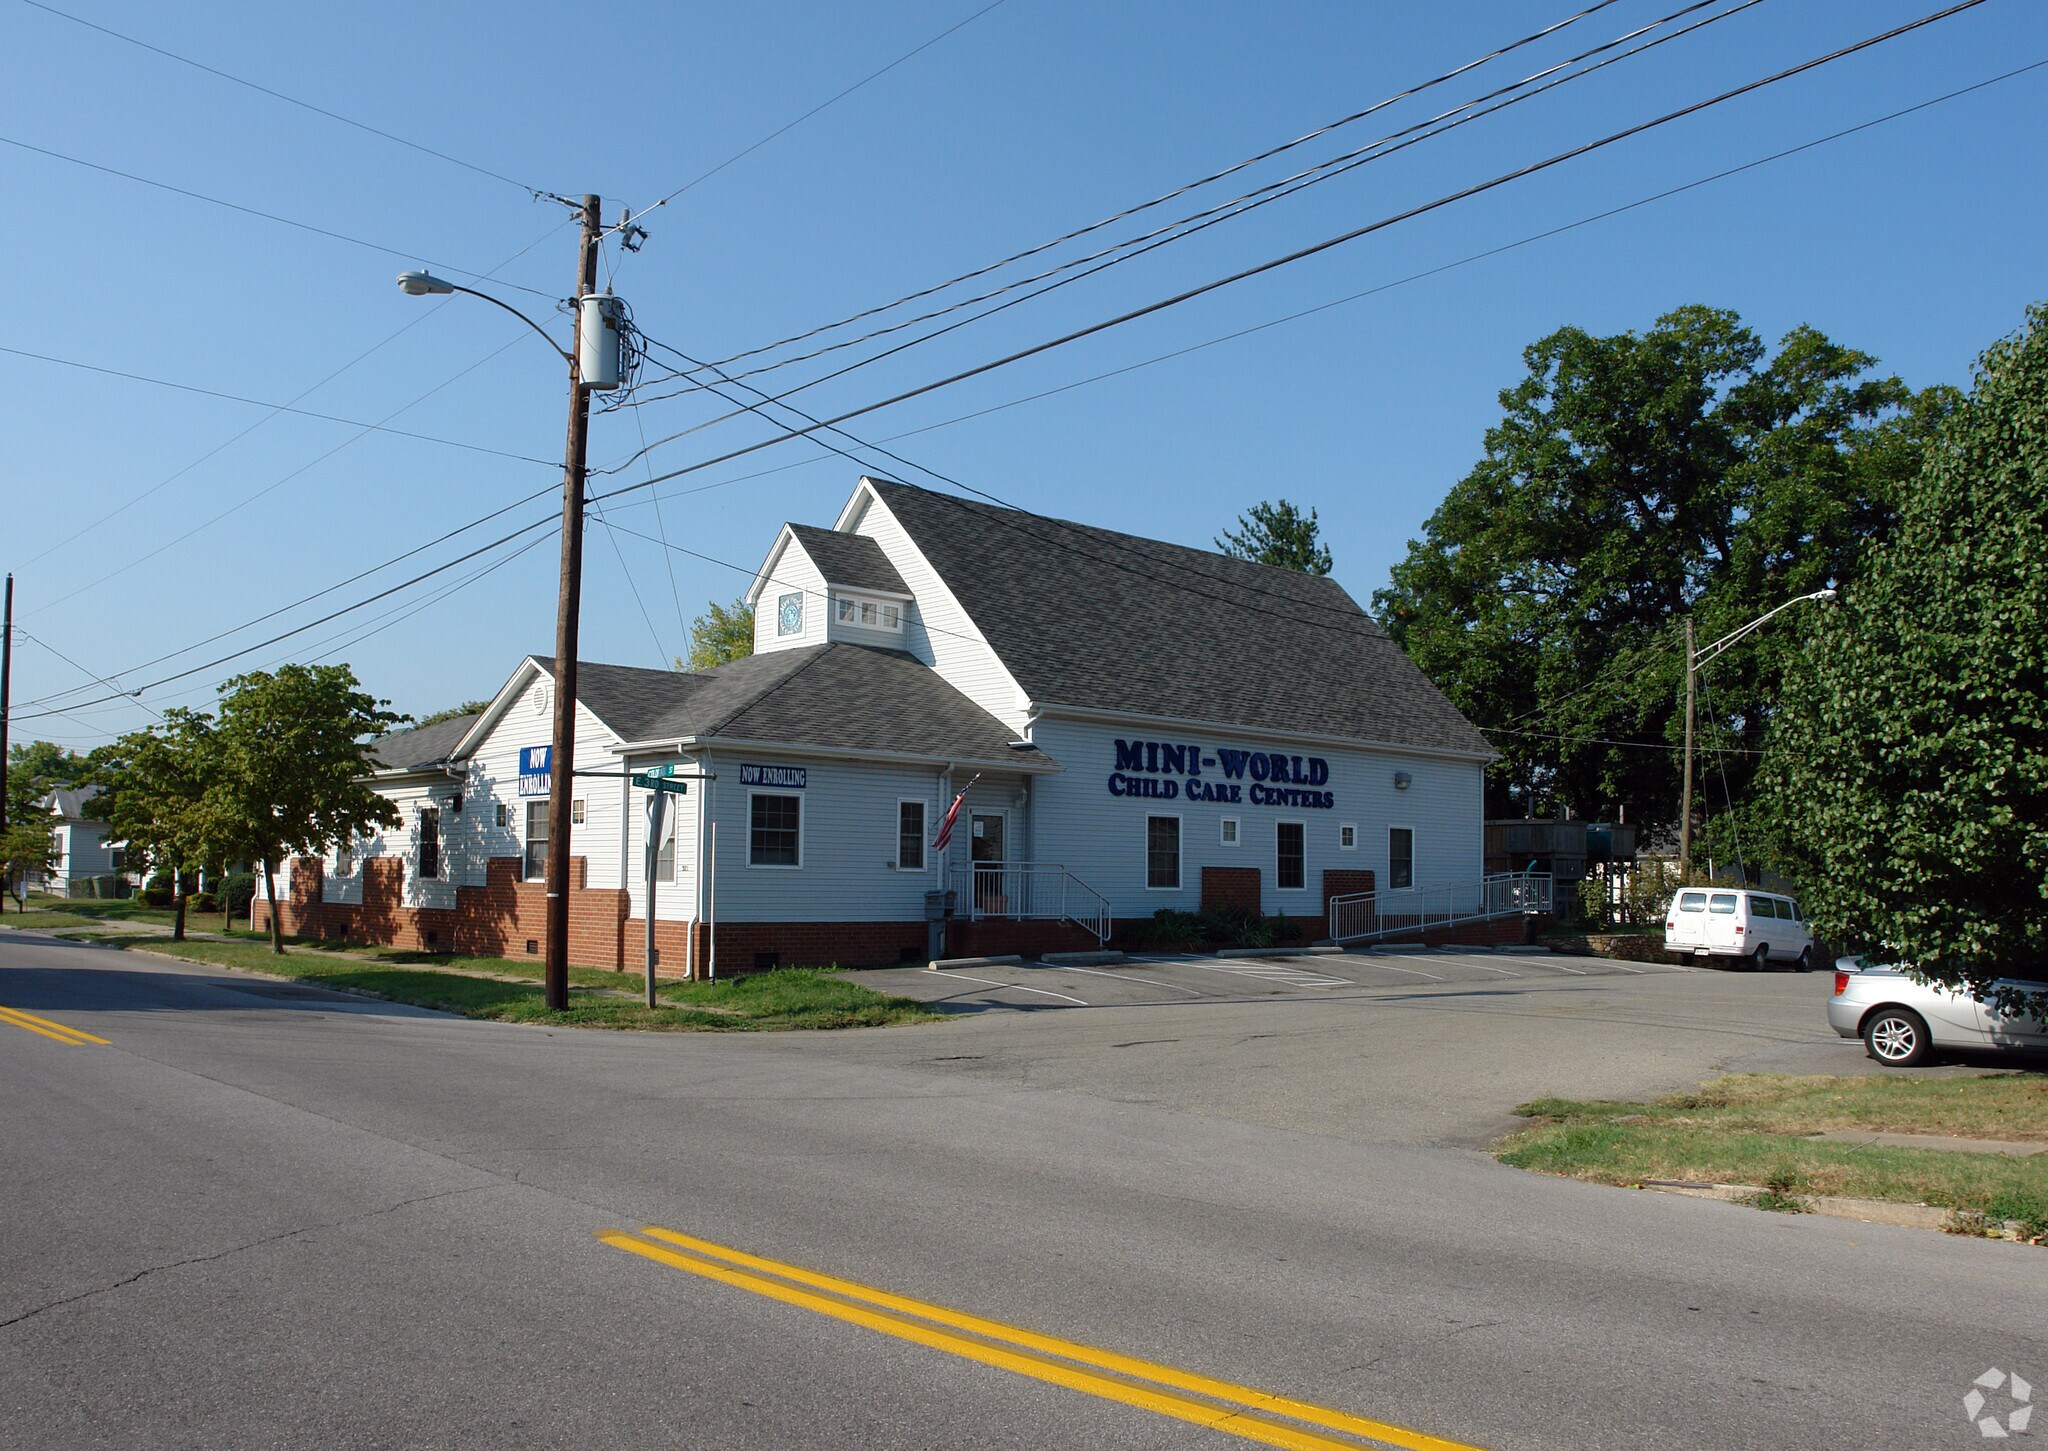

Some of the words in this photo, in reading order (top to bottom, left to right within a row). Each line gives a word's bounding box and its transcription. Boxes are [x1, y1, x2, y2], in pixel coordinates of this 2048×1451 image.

[530, 747, 547, 769] NOW
[1114, 739, 1329, 786] MINI-WORLD
[520, 772, 552, 795] ENROLLIN
[635, 776, 642, 786] E
[644, 777, 660, 789] 3RD
[662, 781, 685, 792] STREET
[741, 766, 760, 783] NOW
[762, 767, 805, 786] ENROLLING
[1108, 772, 1179, 799] CHILD
[1185, 778, 1242, 803] CARE
[1249, 783, 1334, 809] CENTERS
